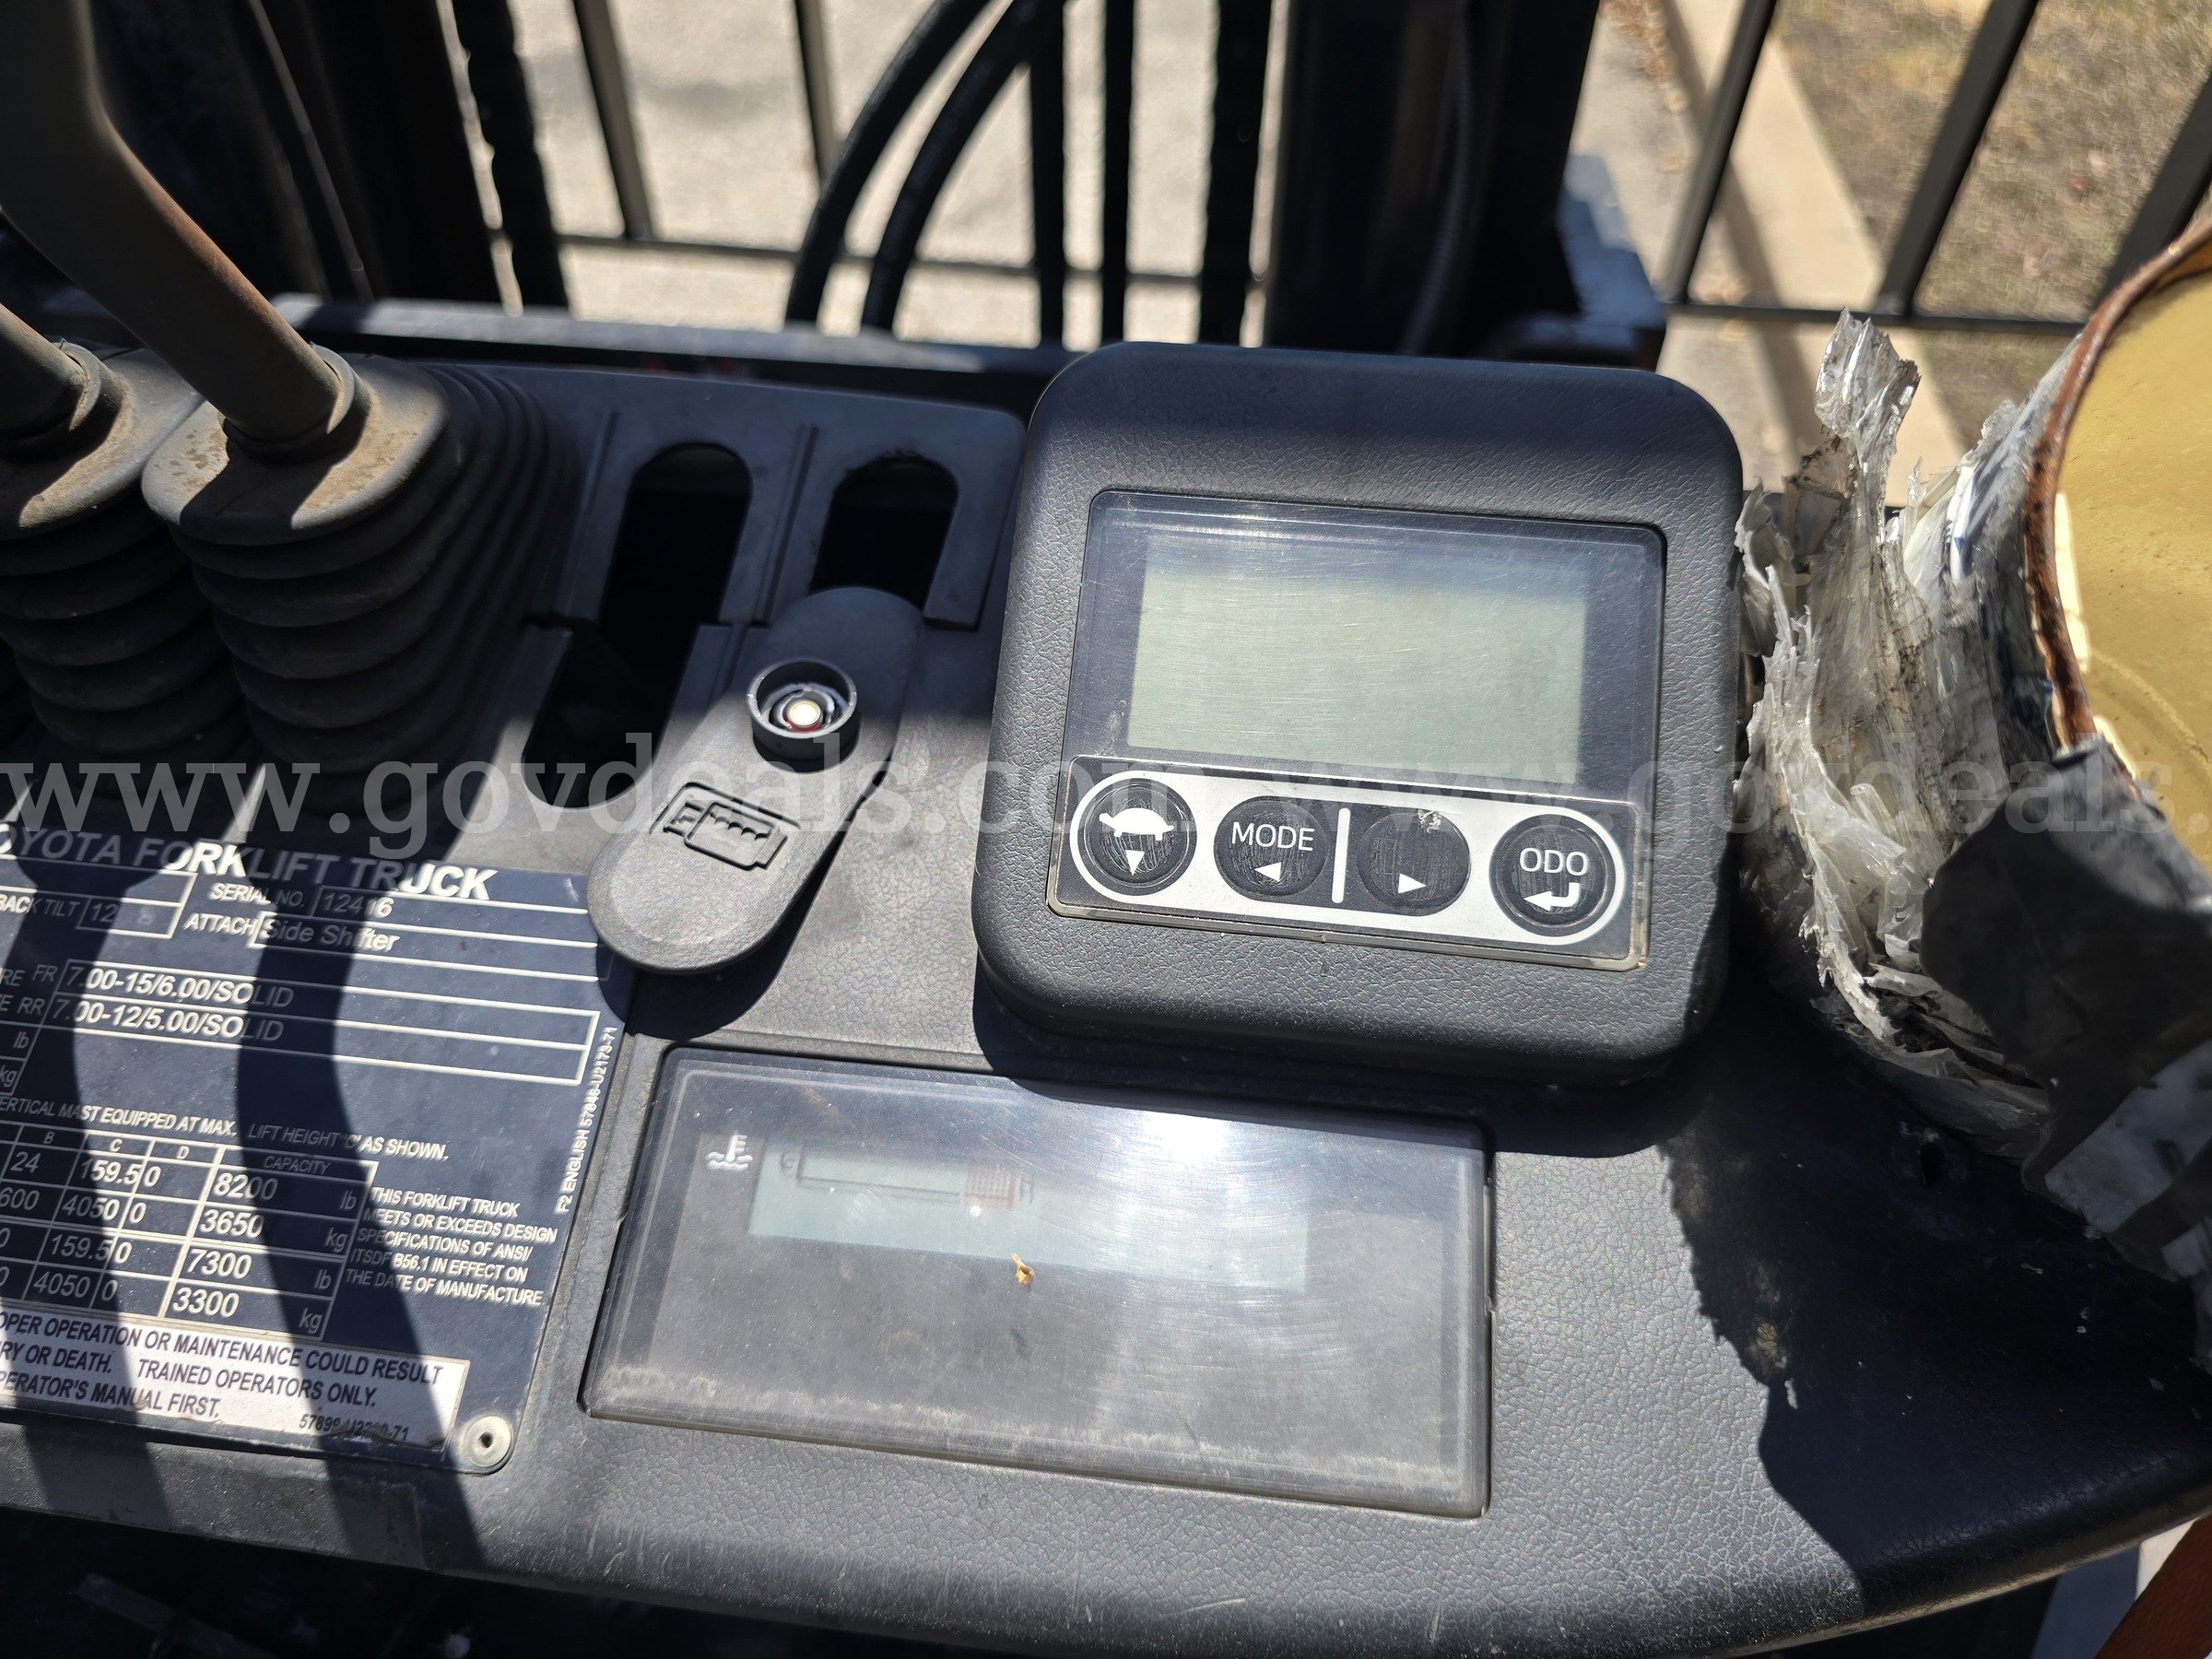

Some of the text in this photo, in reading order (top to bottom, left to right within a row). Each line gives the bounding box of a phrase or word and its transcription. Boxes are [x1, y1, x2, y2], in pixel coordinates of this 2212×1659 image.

[1231, 821, 1315, 842] MODE
[134, 838, 342, 884] FORKLIFT
[349, 857, 499, 900] TRUCK
[1520, 847, 1589, 877] ODO
[44, 899, 81, 918] TILT
[92, 902, 121, 922] 12
[208, 882, 394, 918] SERIAL NO. 12416
[184, 912, 401, 952] ATTACH Side Shifter
[32, 964, 57, 982] FR
[66, 966, 294, 1007] 7.00-15/6.00/SOLID
[18, 996, 46, 1015] RR
[53, 998, 285, 1041] 7.00-12/5.00/SOLID
[13, 1031, 29, 1049] lb
[57, 1103, 98, 1122] MAST
[100, 1108, 177, 1130] EQUIPPED
[175, 1116, 201, 1132] AT
[198, 1118, 239, 1137] MAX.
[248, 1124, 283, 1139] LIFT
[282, 1128, 340, 1146] HEIGHT
[358, 1135, 384, 1153] AS
[43, 1131, 331, 1174] B C D CAPACITY
[559, 1129, 591, 1194] ENGLISH
[10, 1151, 357, 1210] 24 159.5 0 8200 lb
[370, 1186, 521, 1218] THIS FORKLIFT TRUCK
[554, 1194, 573, 1216] F2
[63, 1194, 121, 1221] 4050
[129, 1202, 147, 1224] 0
[200, 1209, 265, 1238] 3650
[325, 1228, 347, 1253] kg
[357, 1228, 471, 1256] SPECIFICATIONS
[472, 1241, 494, 1258] OF
[362, 1208, 559, 1244] MEETS OR EXCEEDS DESIGN
[52, 1233, 113, 1261] 159.5
[114, 1241, 133, 1265] 0
[187, 1248, 253, 1279] 7300
[314, 1268, 332, 1289] lb
[349, 1248, 529, 1285] ITSDF B56.1 IN EFFECT ON
[346, 1269, 374, 1286] THE
[374, 1271, 414, 1291] DATE
[414, 1277, 438, 1294] OF
[33, 1271, 91, 1299] 4050
[101, 1279, 119, 1301] 0
[172, 1288, 241, 1318] 3300
[299, 1308, 324, 1335] kg
[44, 1317, 143, 1347] OPERATION
[145, 1330, 170, 1351] OR
[173, 1334, 303, 1367] MAINTENANCE
[306, 1350, 369, 1375] COULD
[371, 1359, 443, 1384] RESULT
[25, 1344, 53, 1365] OR
[53, 1348, 112, 1374] DEATH.
[137, 1359, 213, 1385] TRAINED
[215, 1368, 324, 1400] OPERATORS
[327, 1382, 378, 1407] ONLY.
[91, 1382, 163, 1410] MANUAL
[168, 1393, 222, 1418] FIRST.
